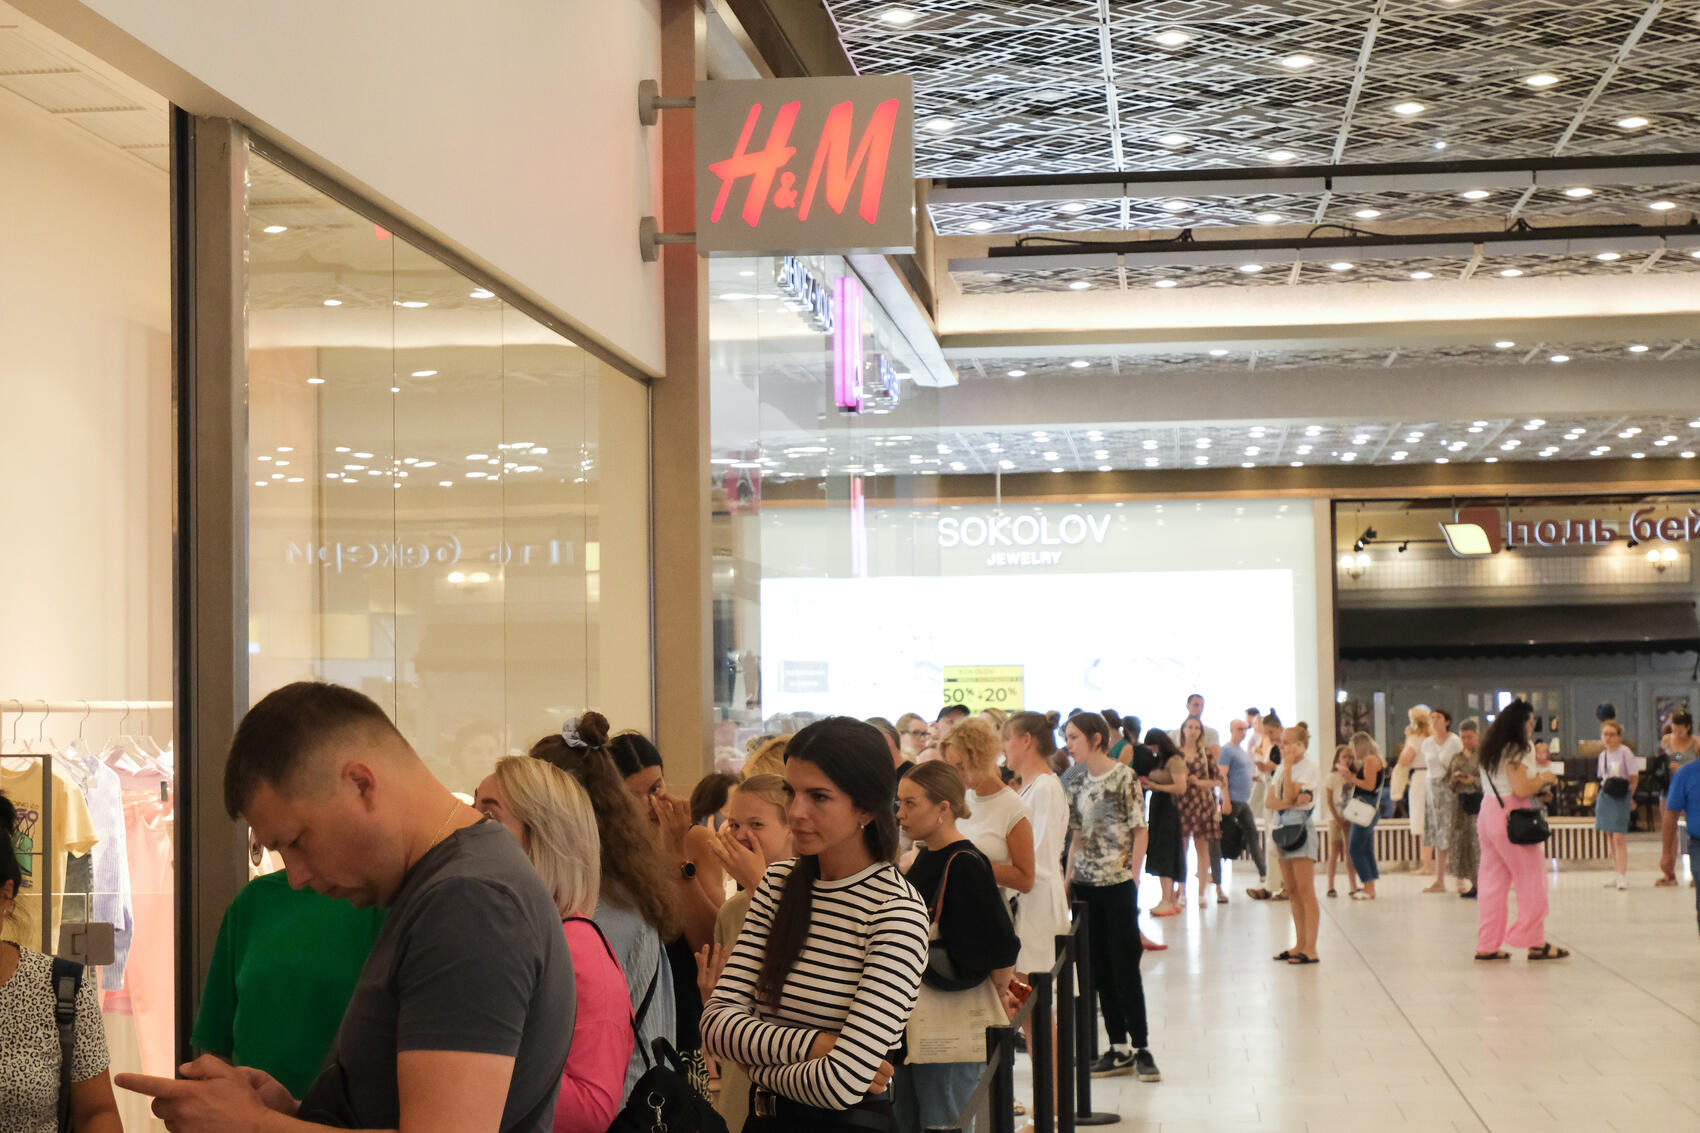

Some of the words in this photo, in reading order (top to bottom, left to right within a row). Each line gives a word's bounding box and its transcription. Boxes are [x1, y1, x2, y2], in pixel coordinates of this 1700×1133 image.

[708, 98, 899, 227] H&M
[937, 514, 1112, 547] SOKOLOV
[1508, 518, 1618, 547] поль
[986, 551, 1062, 566] JEWELRY
